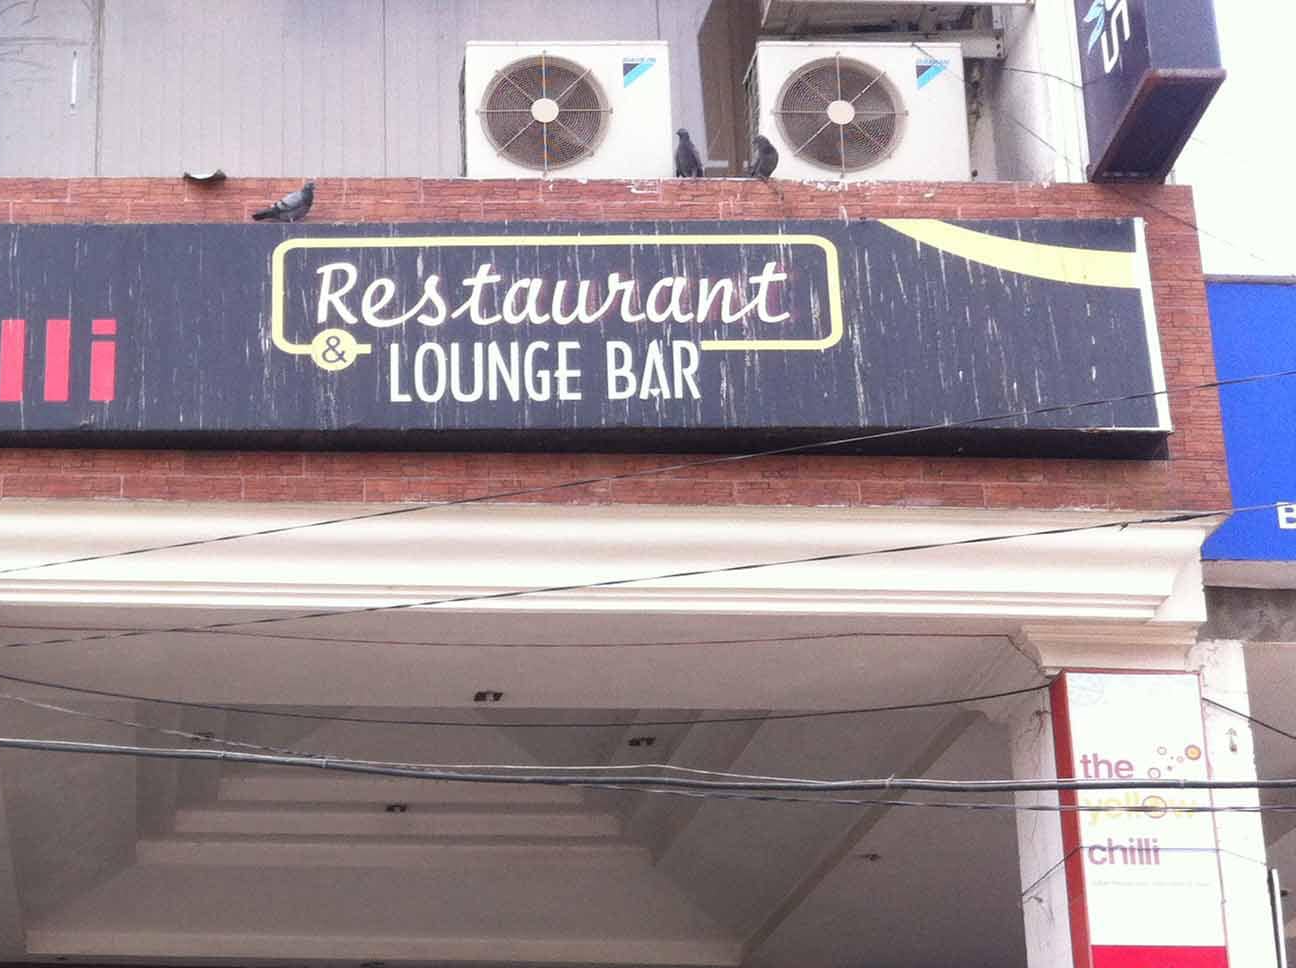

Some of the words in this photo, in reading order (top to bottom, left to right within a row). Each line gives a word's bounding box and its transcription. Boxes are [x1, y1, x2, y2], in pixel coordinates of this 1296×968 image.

[316, 261, 791, 329] Restaurant
[321, 335, 348, 364] &
[389, 340, 582, 403] LOUNGE
[606, 339, 702, 402] BAR
[1080, 753, 1134, 780] the
[1088, 838, 1161, 866] chilli
